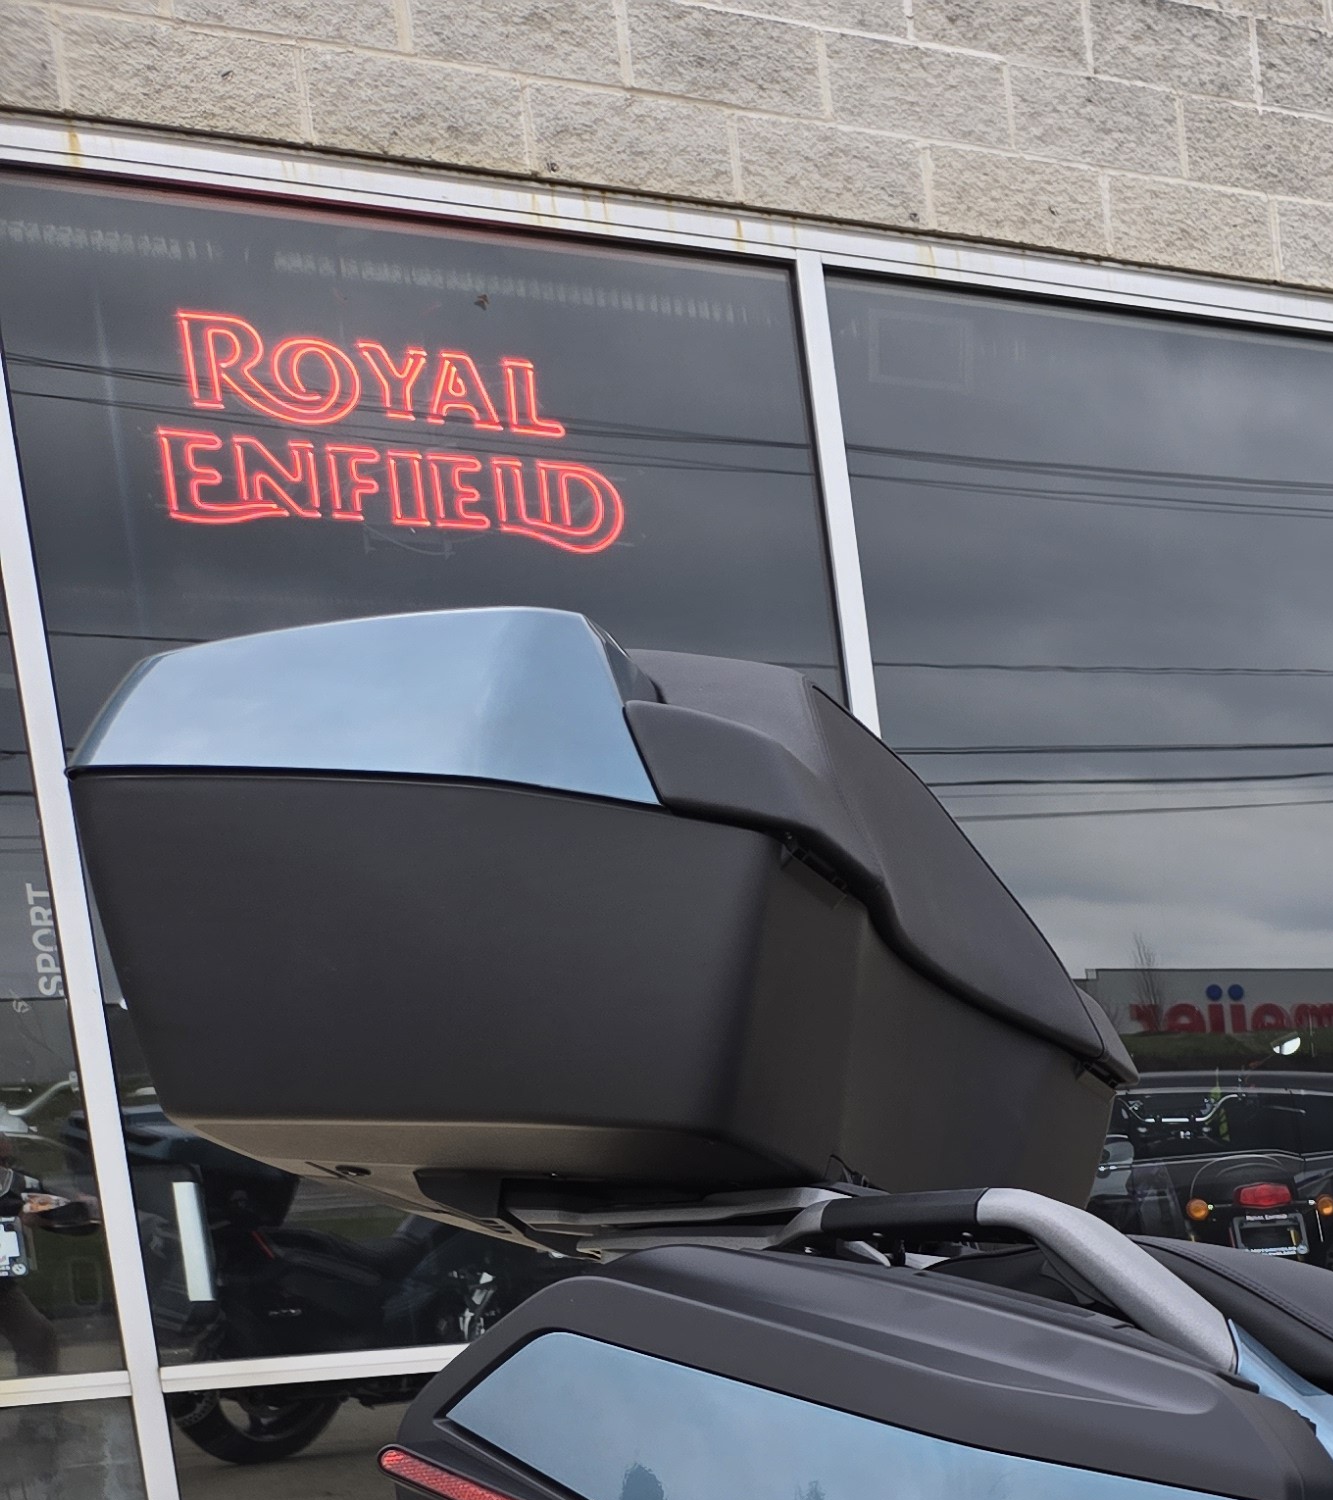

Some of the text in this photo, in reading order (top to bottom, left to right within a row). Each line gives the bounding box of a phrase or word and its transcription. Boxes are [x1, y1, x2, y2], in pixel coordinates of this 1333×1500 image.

[176, 309, 566, 438] ROYAL
[156, 425, 625, 555] ENFIELD
[25, 882, 66, 997] SPORT
